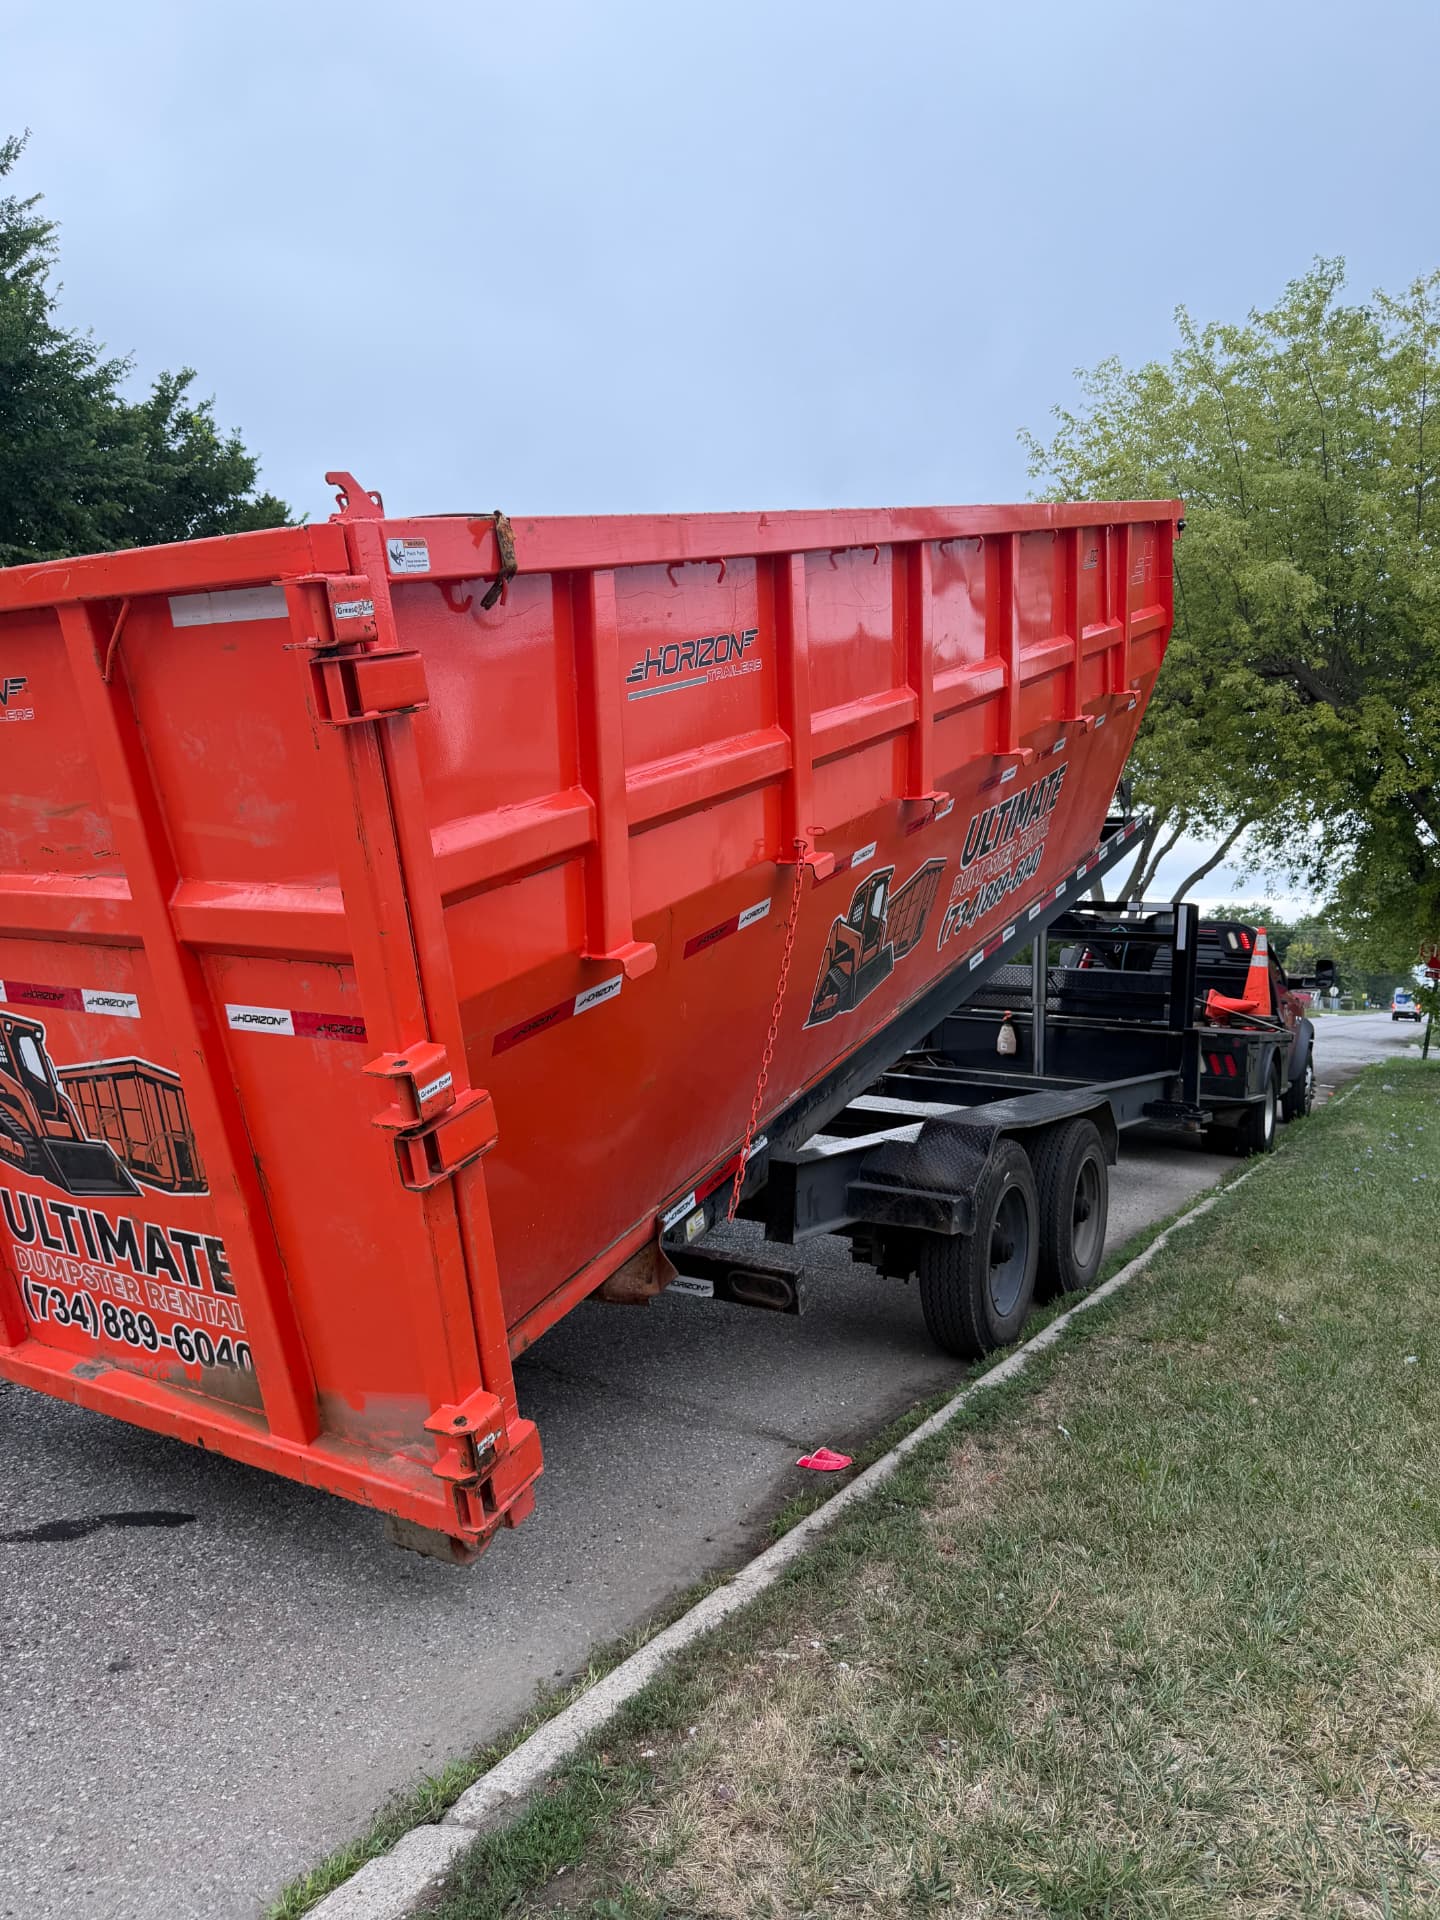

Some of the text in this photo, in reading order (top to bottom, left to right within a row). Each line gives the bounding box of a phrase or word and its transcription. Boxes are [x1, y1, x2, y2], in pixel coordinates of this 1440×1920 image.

[644, 632, 744, 680] HORIZON
[706, 659, 762, 682] TRAILERS
[960, 761, 1068, 870] ULTIMATE
[92, 996, 130, 1009] HORIZON
[237, 1013, 282, 1026] HORIZON
[0, 1187, 238, 1298] ULTIMATE
[13, 1244, 246, 1333] DUMPSTER RENTAL
